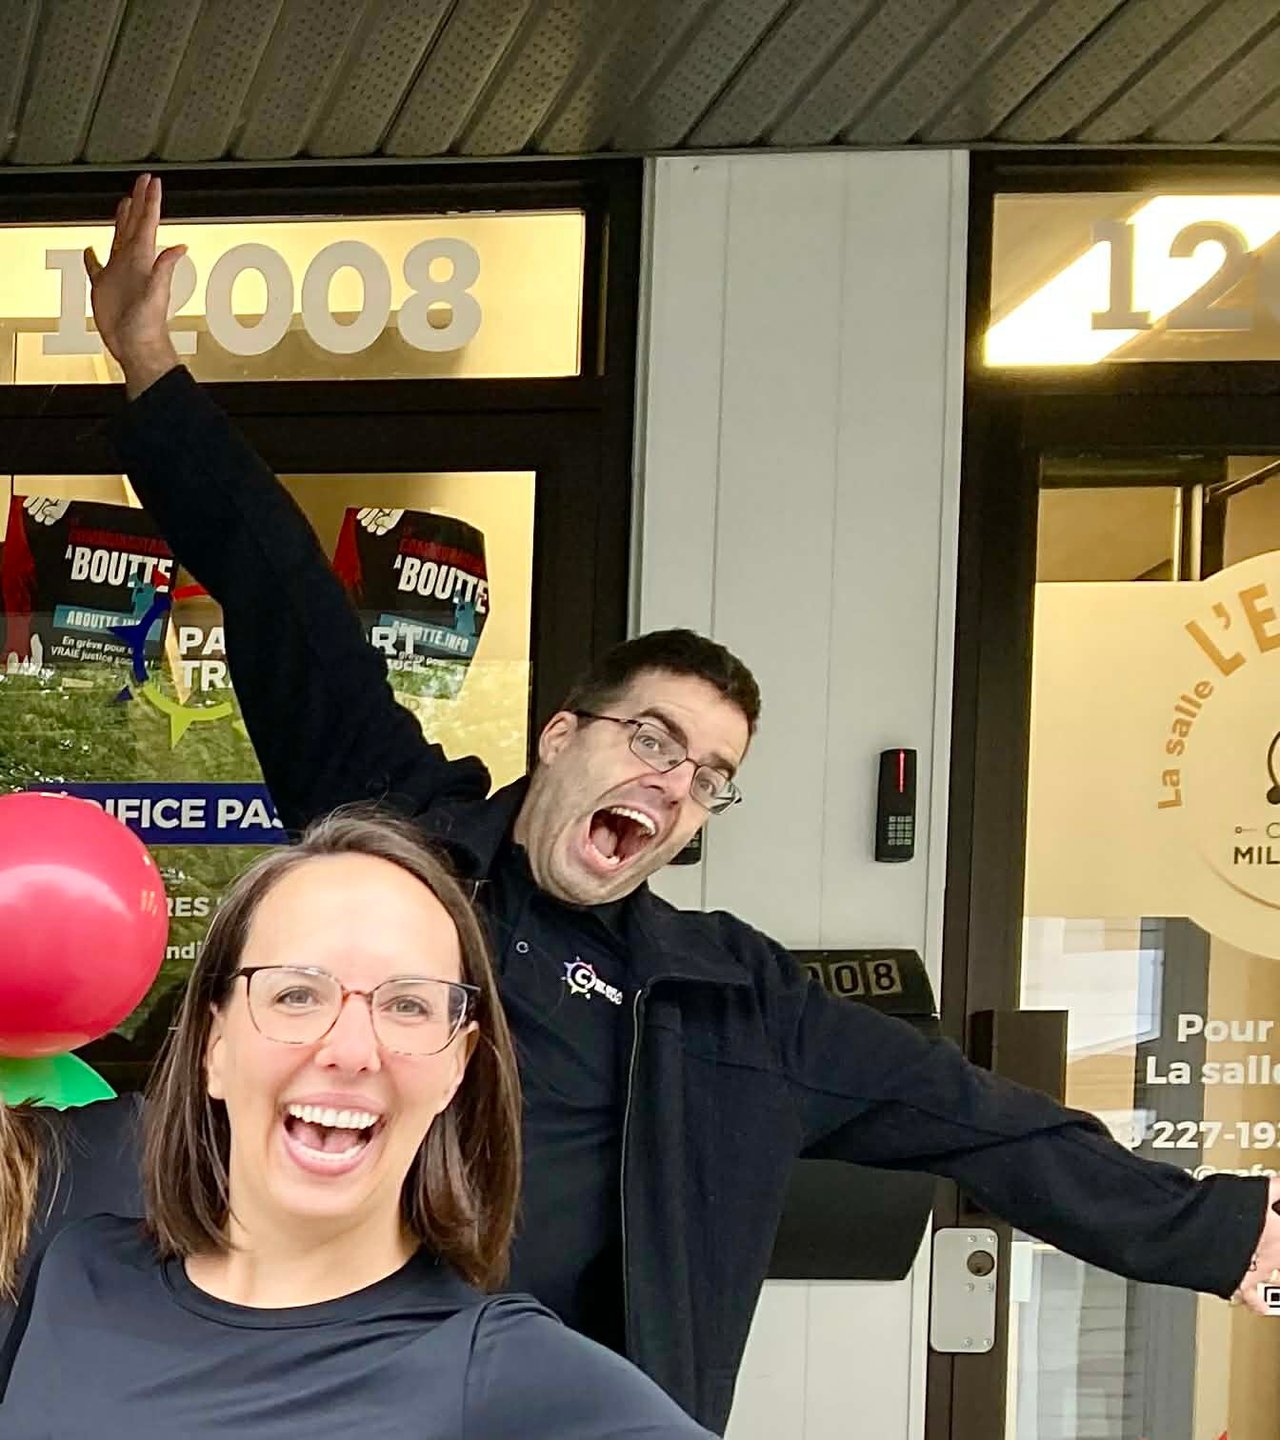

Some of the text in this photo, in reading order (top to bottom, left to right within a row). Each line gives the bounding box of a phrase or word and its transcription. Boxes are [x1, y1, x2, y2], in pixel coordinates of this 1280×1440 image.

[1090, 219, 1280, 331] 12
[1157, 680, 1215, 810] La salle
[1177, 1013, 1274, 1043] Pour
[1146, 1056, 1191, 1085] La
[1152, 1120, 1280, 1150] 227-19
